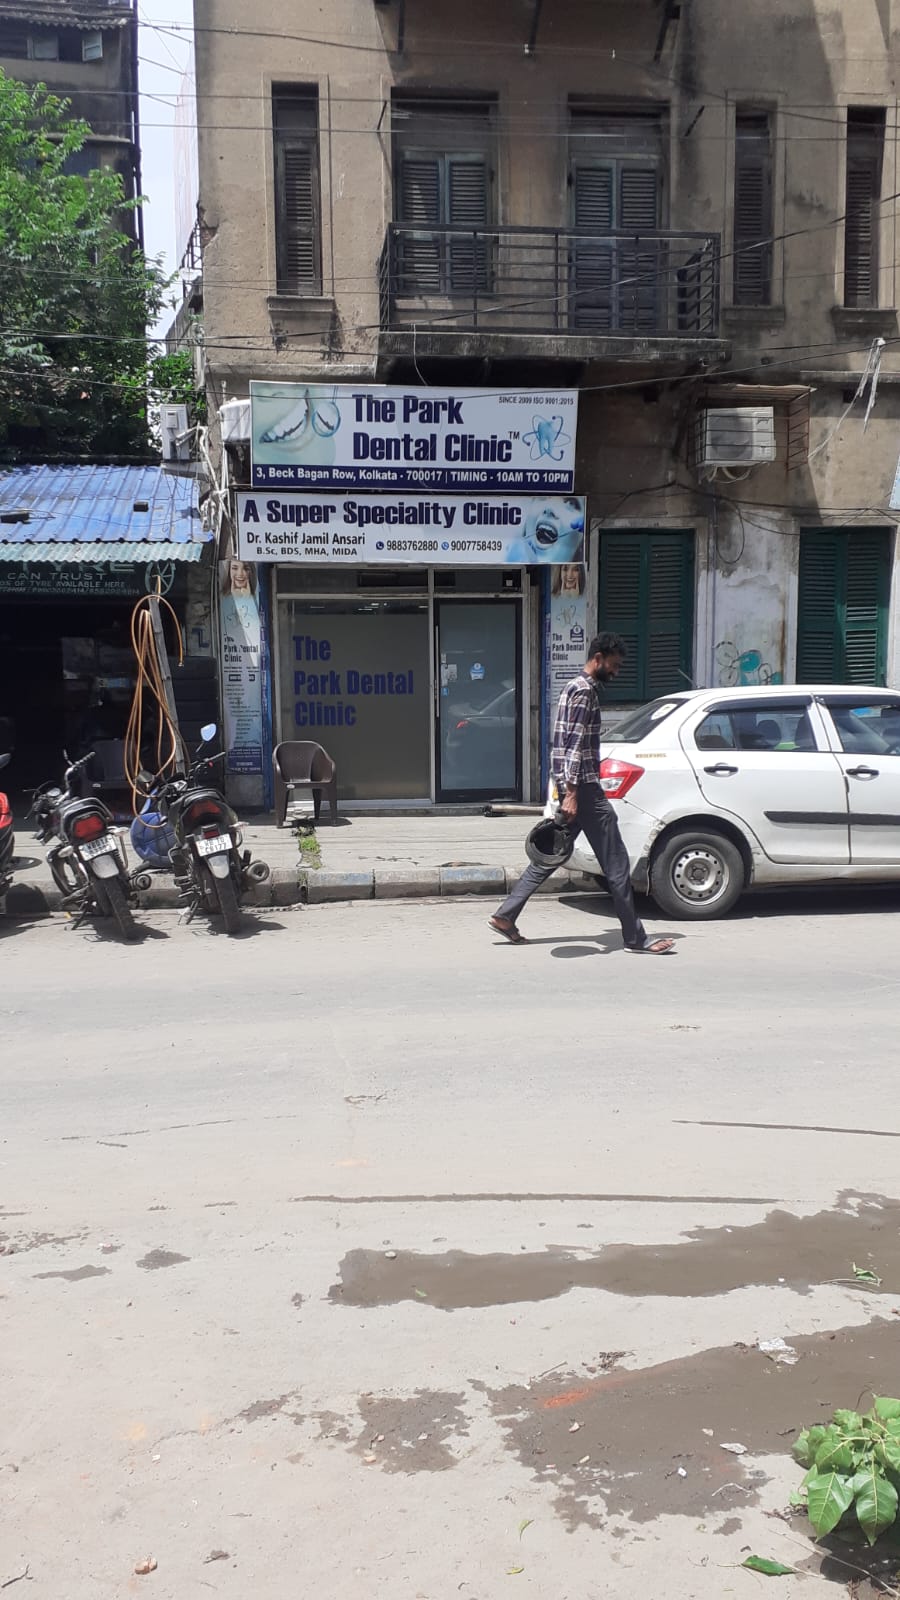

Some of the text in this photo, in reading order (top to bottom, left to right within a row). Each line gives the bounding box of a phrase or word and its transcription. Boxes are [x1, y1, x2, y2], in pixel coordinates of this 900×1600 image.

[498, 396, 517, 404] SINCE
[533, 396, 544, 405] ISO
[352, 394, 464, 425] The Park
[352, 432, 437, 462] Dental
[444, 433, 512, 463] Clinic
[256, 467, 266, 479] 3,
[268, 467, 295, 479] Beck
[297, 468, 330, 482] Bagan
[332, 469, 357, 482] Row,
[359, 469, 398, 481] Kolkata
[406, 470, 443, 482] 700017
[451, 471, 487, 482] TIMING
[496, 472, 523, 483] 10AM
[526, 472, 539, 483] TO
[542, 472, 569, 484] 10PM
[243, 499, 522, 528] A Super Speciality Clinic
[247, 532, 366, 546] Dr. Kashif Jamil Ansari
[386, 540, 503, 552] 9883762880 9007758439
[256, 546, 358, 558] B.Sc, BDS, MHA, MIDA
[7, 572, 107, 581] CAN TRUST
[552, 633, 563, 641] The
[292, 635, 332, 662] The
[552, 643, 585, 652] Park Dental
[294, 669, 414, 696] Park Dental
[295, 701, 357, 727] Clinic
